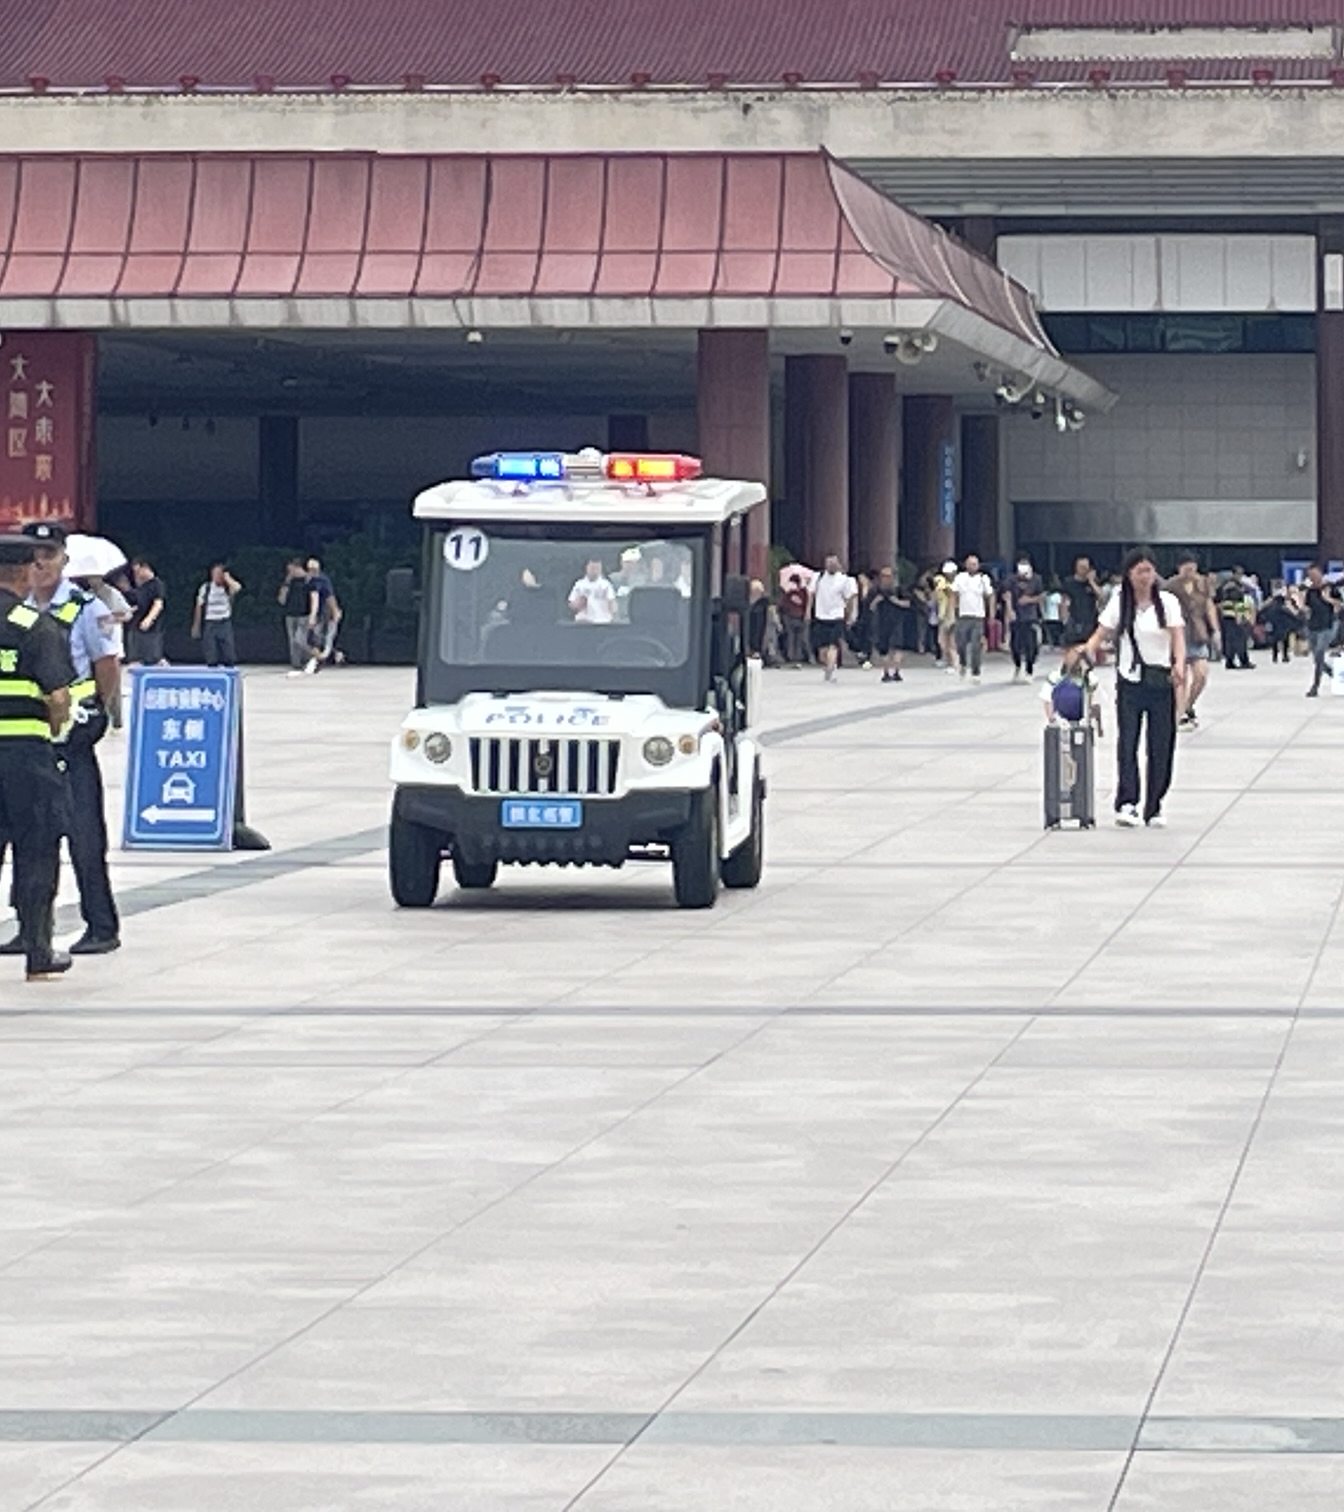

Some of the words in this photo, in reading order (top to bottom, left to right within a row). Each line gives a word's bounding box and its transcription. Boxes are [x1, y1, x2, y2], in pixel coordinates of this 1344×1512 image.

[450, 534, 481, 561] 11
[161, 718, 205, 741] 东侧
[156, 749, 207, 768] TAXI
